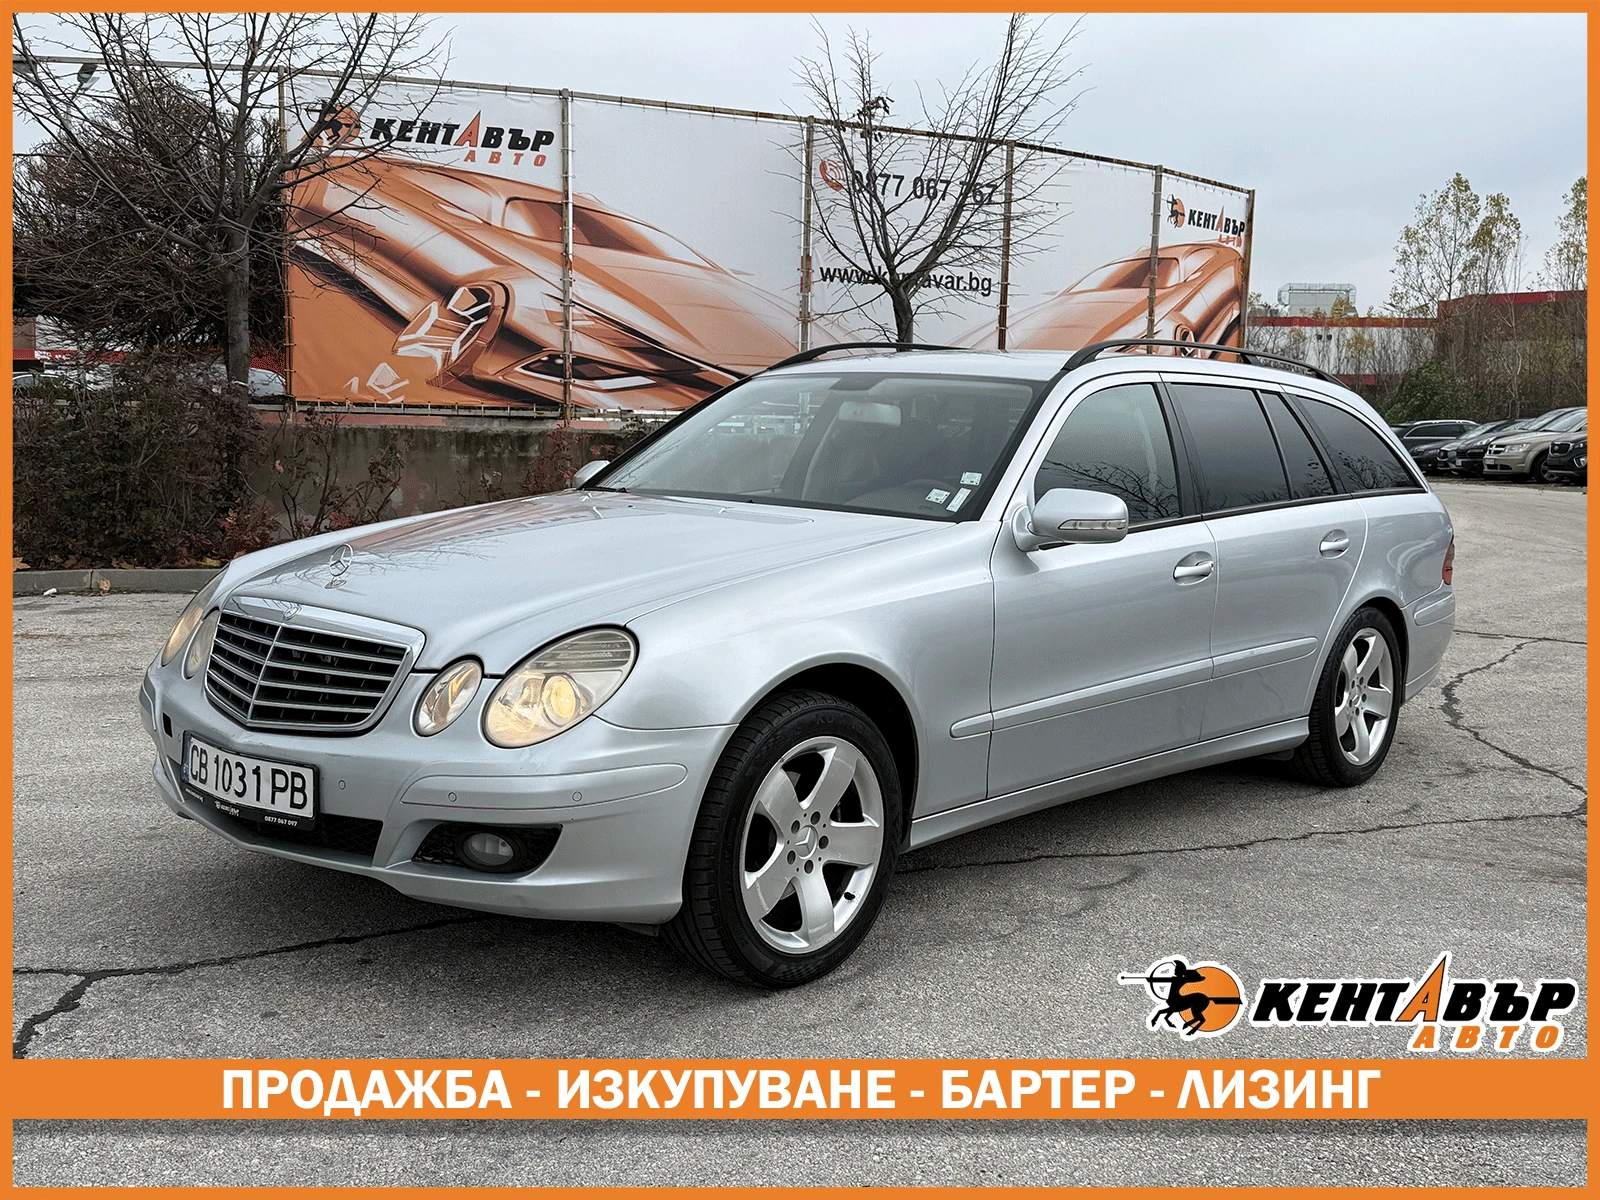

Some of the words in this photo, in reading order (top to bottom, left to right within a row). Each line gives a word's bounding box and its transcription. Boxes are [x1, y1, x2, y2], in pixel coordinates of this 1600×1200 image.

[370, 110, 555, 152] КЕНТАВЪР
[464, 149, 547, 167] АВТО
[912, 176, 951, 202] 067
[1188, 205, 1246, 237] КЕНТАВЪР
[214, 754, 261, 803] 1031
